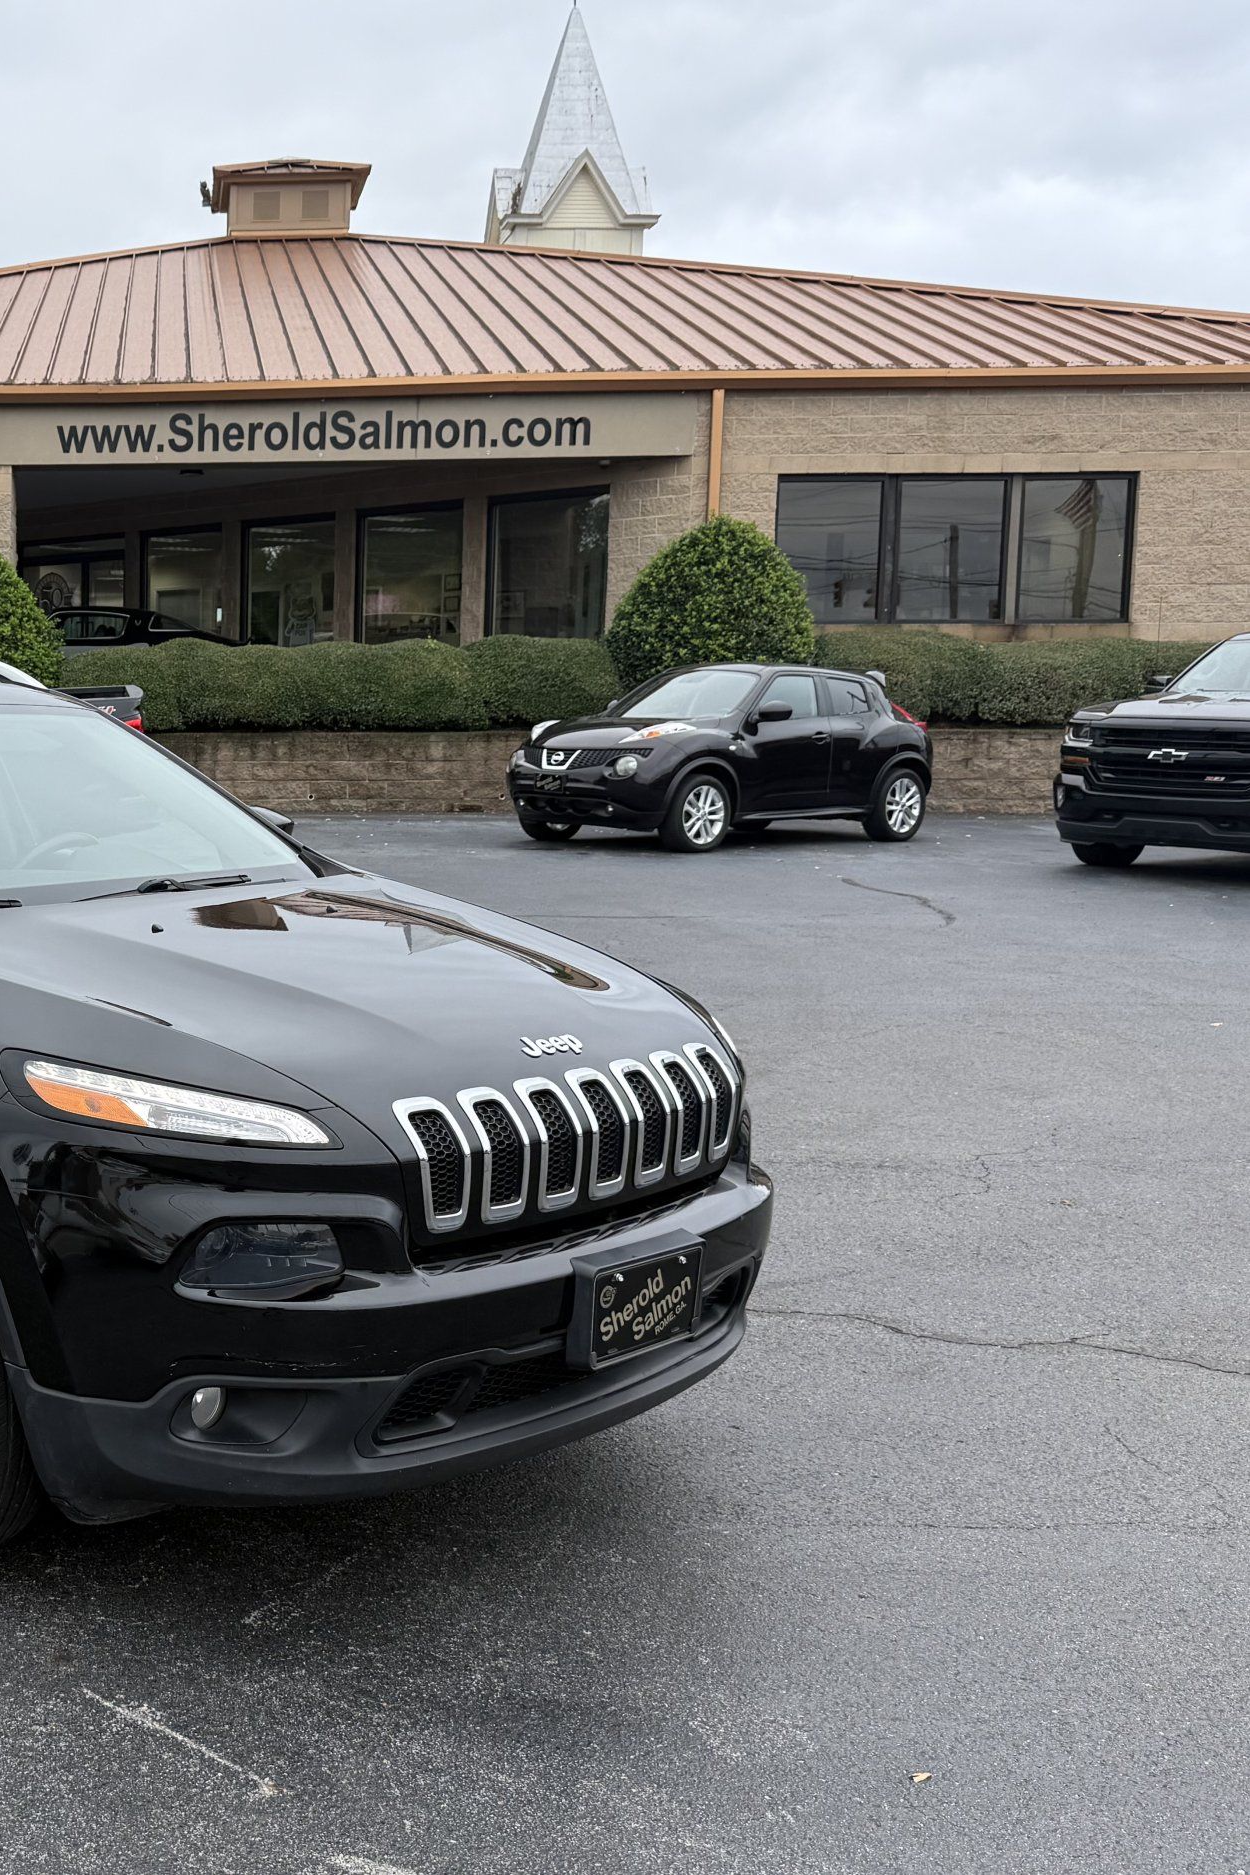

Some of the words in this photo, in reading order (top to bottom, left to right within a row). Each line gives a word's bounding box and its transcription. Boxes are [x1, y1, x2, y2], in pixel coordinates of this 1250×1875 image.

[57, 410, 591, 453] www.SheroldSalmon.com
[519, 1033, 584, 1058] Jeep
[600, 1268, 664, 1341] Sherold
[632, 1276, 692, 1341] Salmon
